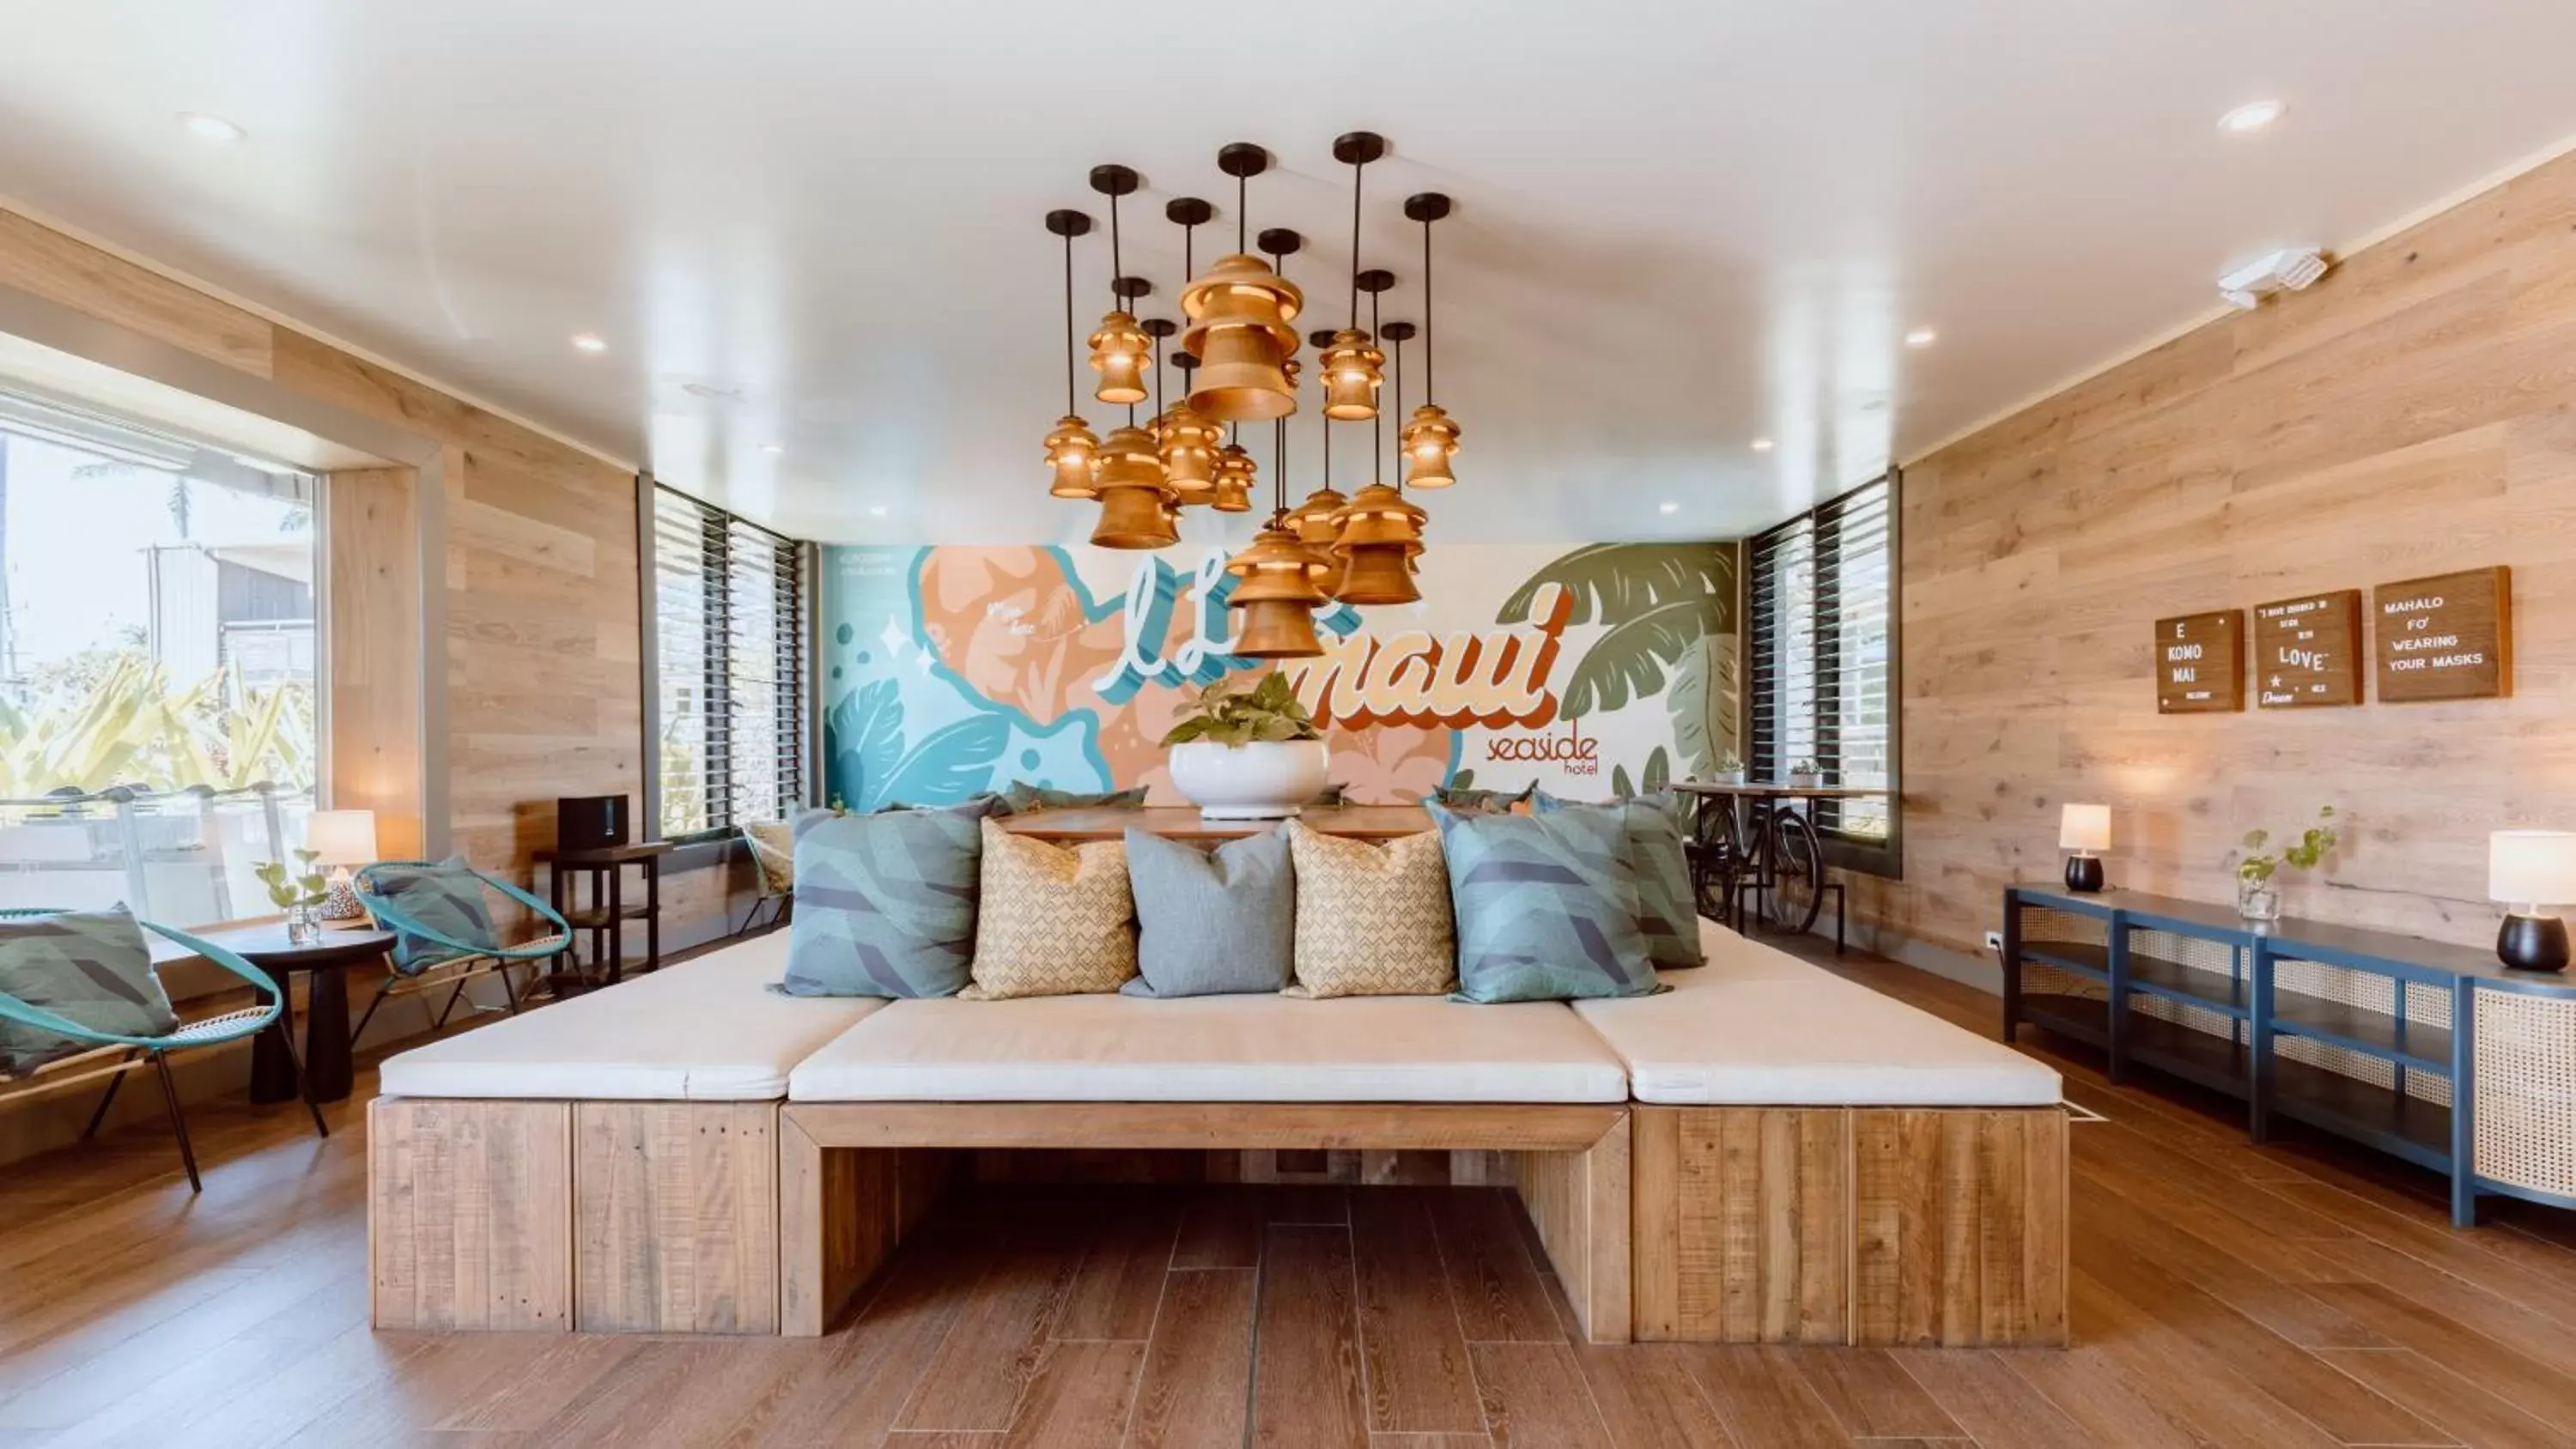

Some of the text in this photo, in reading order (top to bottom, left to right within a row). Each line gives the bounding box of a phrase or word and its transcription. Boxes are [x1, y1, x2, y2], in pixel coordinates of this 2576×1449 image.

[2384, 597, 2445, 614] MAHALO
[2177, 622, 2185, 640] E
[2407, 615, 2430, 632] FO'
[2391, 634, 2458, 652] WEARING
[1279, 584, 1568, 726] maui
[2167, 643, 2203, 663] KOMO
[2390, 652, 2483, 672] YOUR MASKS
[2172, 666, 2196, 684] MAI
[1486, 718, 1598, 761] seaside
[1564, 756, 1598, 775] hotel
